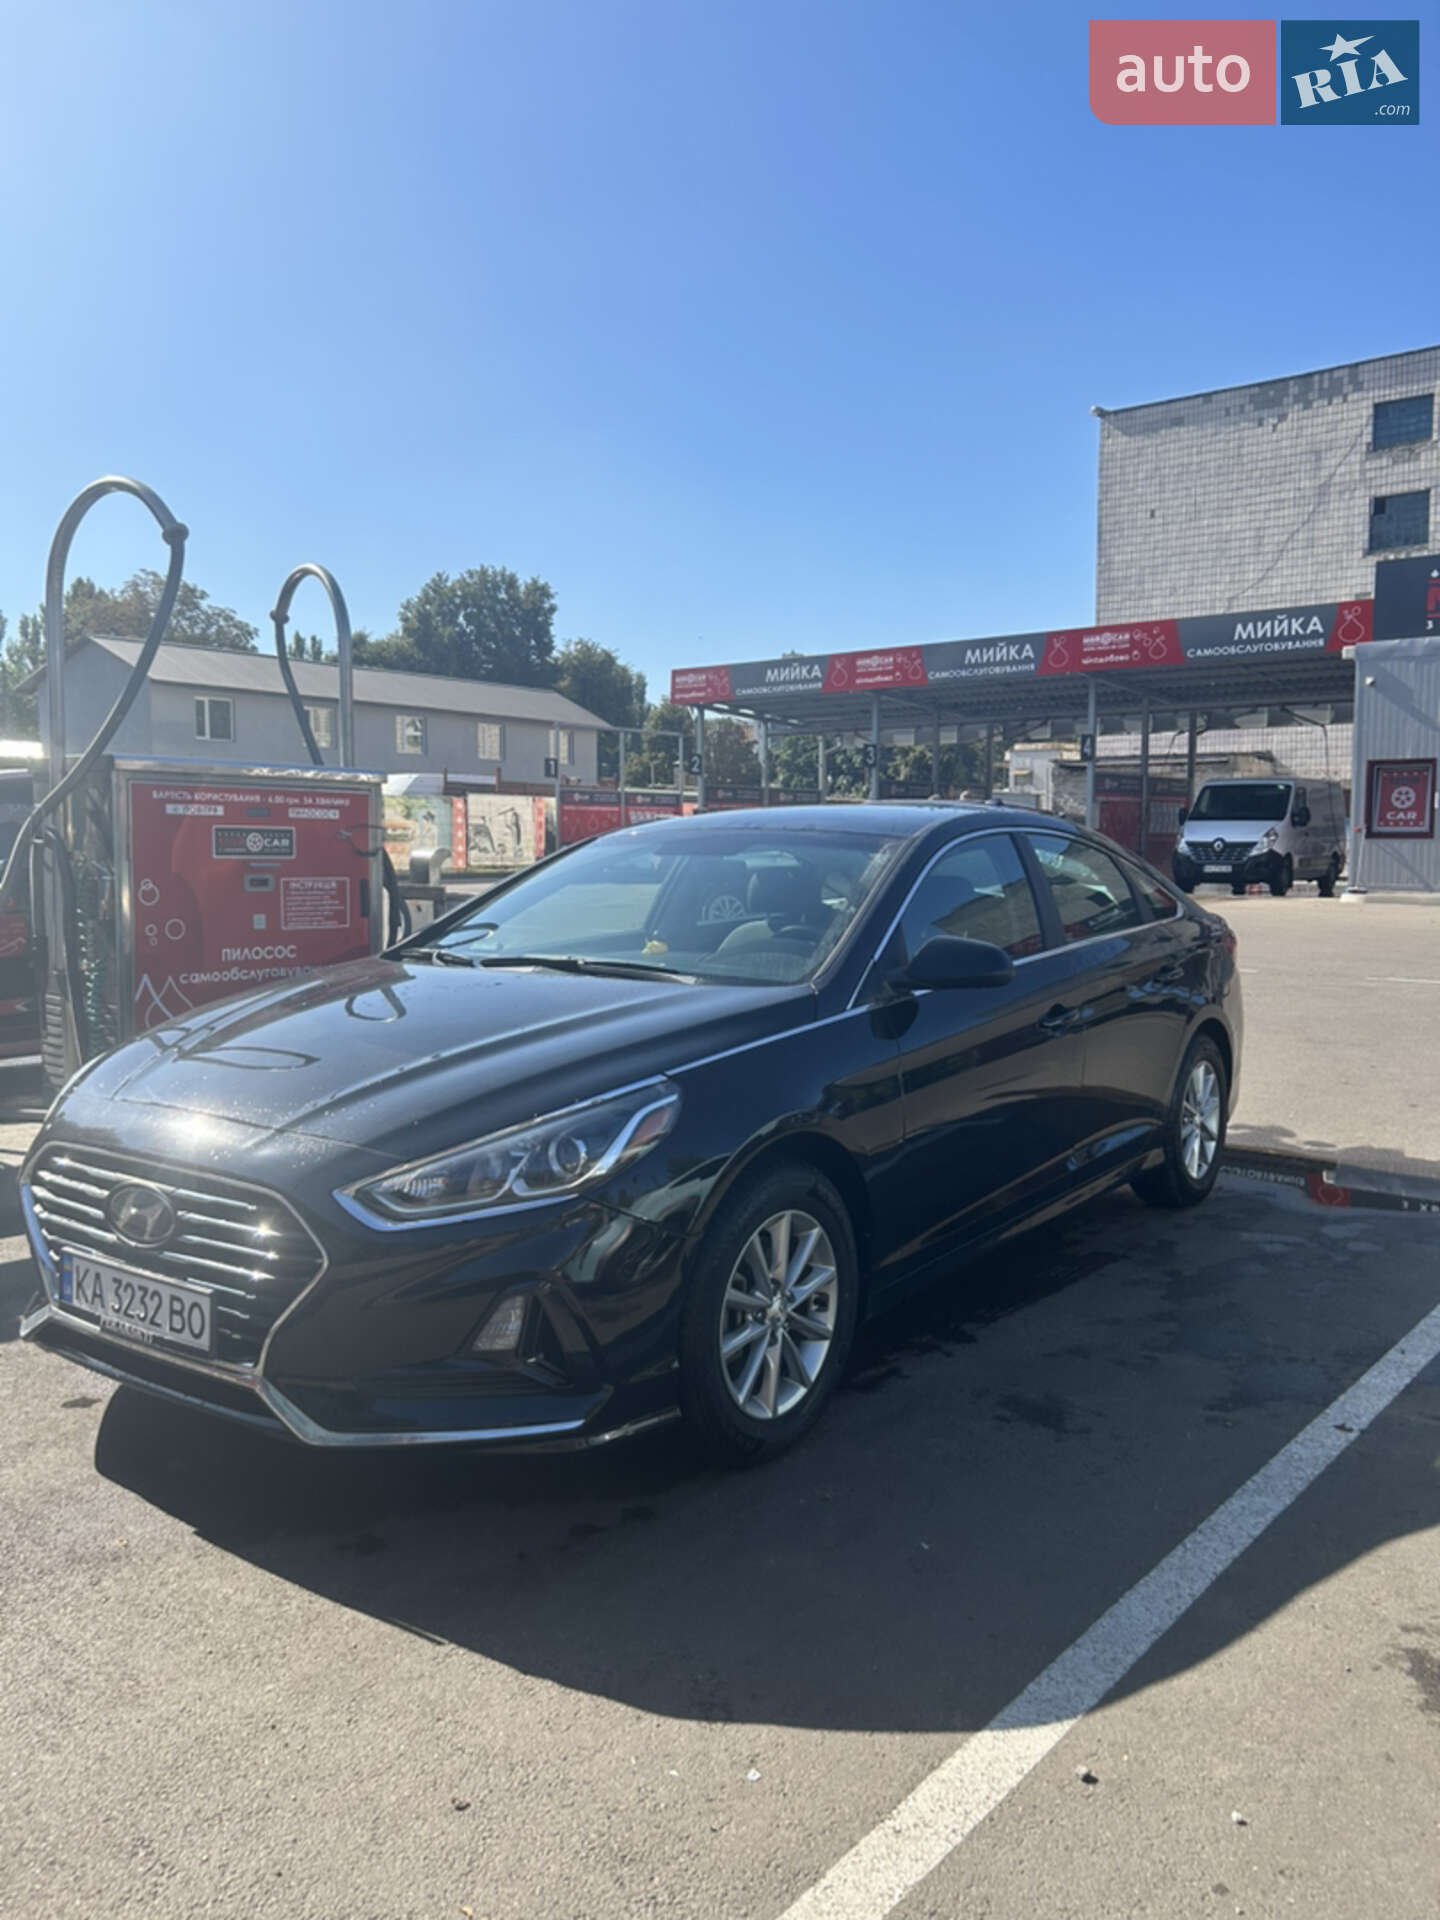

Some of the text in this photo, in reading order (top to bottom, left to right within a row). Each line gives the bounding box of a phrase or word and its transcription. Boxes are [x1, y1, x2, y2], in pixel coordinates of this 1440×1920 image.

[1233, 613, 1324, 641] МИЙКА
[964, 641, 1035, 665] МИЙКА
[1186, 637, 1326, 658] САМООБСЛУГОВУВАННЯ
[765, 661, 823, 683] МИЙКА
[866, 747, 876, 766] 3
[1082, 737, 1092, 757] 4
[548, 761, 556, 776] 1
[690, 754, 700, 773] 2
[1386, 811, 1417, 820] CAR
[221, 945, 298, 962] ПИЛОСОС
[75, 1264, 104, 1309] KA
[111, 1277, 163, 1328] 3232
[168, 1294, 206, 1340] BO
